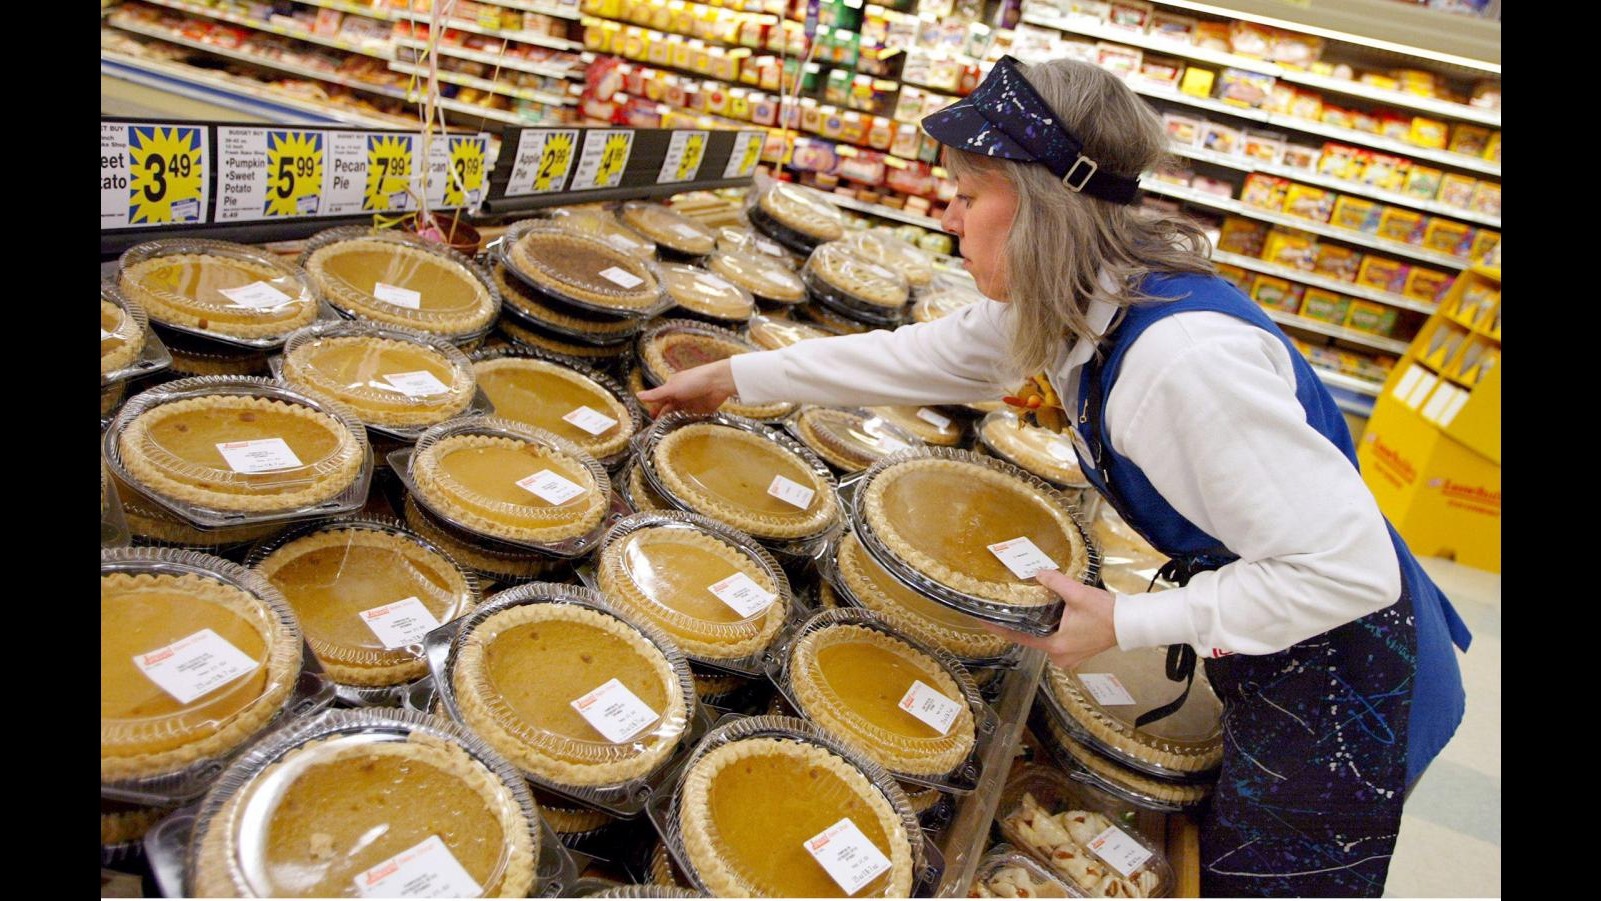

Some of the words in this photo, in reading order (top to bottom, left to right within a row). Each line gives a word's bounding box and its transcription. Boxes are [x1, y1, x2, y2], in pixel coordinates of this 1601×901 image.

[101, 153, 124, 168] eet
[334, 159, 366, 172] Pecan
[101, 174, 127, 189] ato
[333, 176, 350, 190] Pie
[225, 184, 252, 193] Potato
[224, 196, 237, 206] Pie
